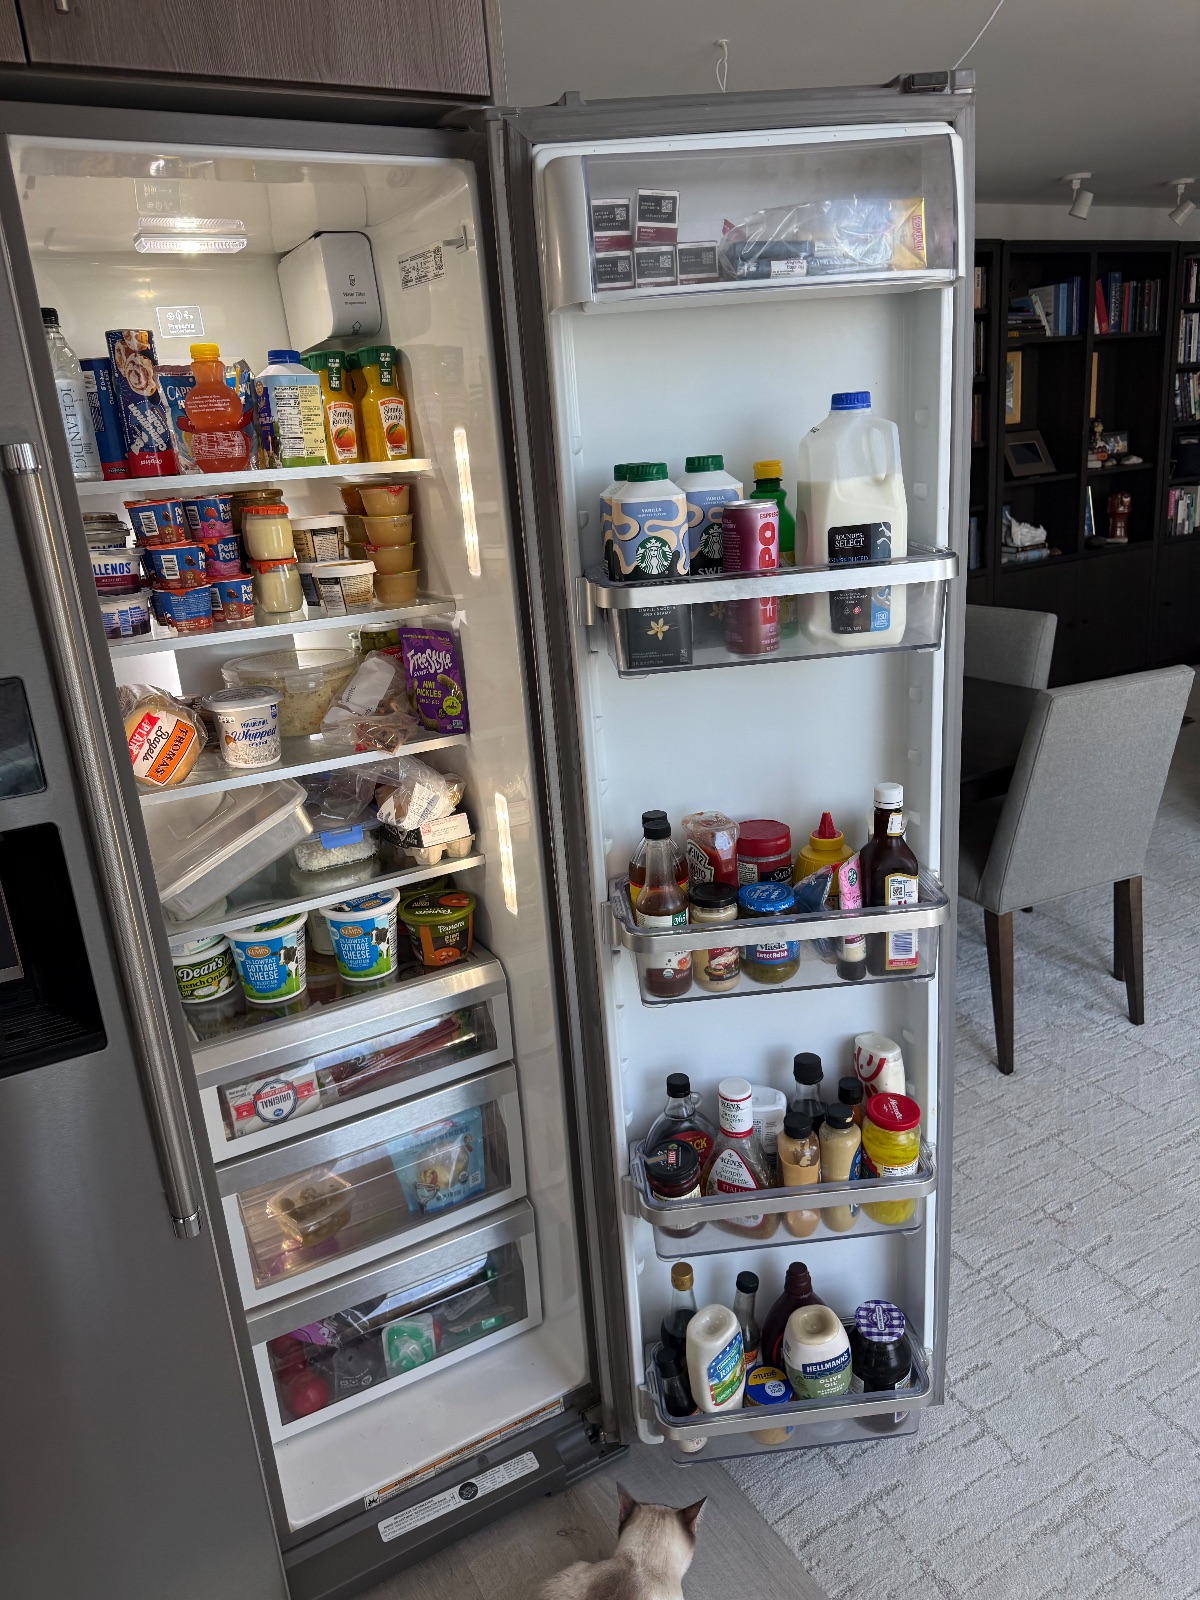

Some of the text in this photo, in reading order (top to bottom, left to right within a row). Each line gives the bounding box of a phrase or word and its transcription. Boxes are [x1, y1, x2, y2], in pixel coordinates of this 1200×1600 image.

[60, 388, 87, 469] ICELANDIC
[834, 538, 865, 548] SELECT
[93, 562, 131, 576] LLENOS
[406, 648, 453, 677] FreeStyle
[416, 688, 442, 699] PICKLES
[231, 725, 277, 742] Whipped
[142, 725, 170, 762] Bagels
[154, 727, 189, 778] THOMAS
[340, 943, 370, 951] COTTAGE
[342, 950, 371, 960] CHEESE
[177, 956, 223, 982] Dean's
[246, 963, 278, 972] COTTAGE
[249, 970, 279, 981] CHEESE
[179, 980, 206, 991] French
[259, 1092, 292, 1109] ORIGINAL
[720, 1157, 743, 1169] KEN'S
[720, 1167, 743, 1178] Simply
[720, 1354, 739, 1378] Ranch
[752, 1370, 777, 1380] garlic
[819, 1374, 842, 1384] OLIVE
